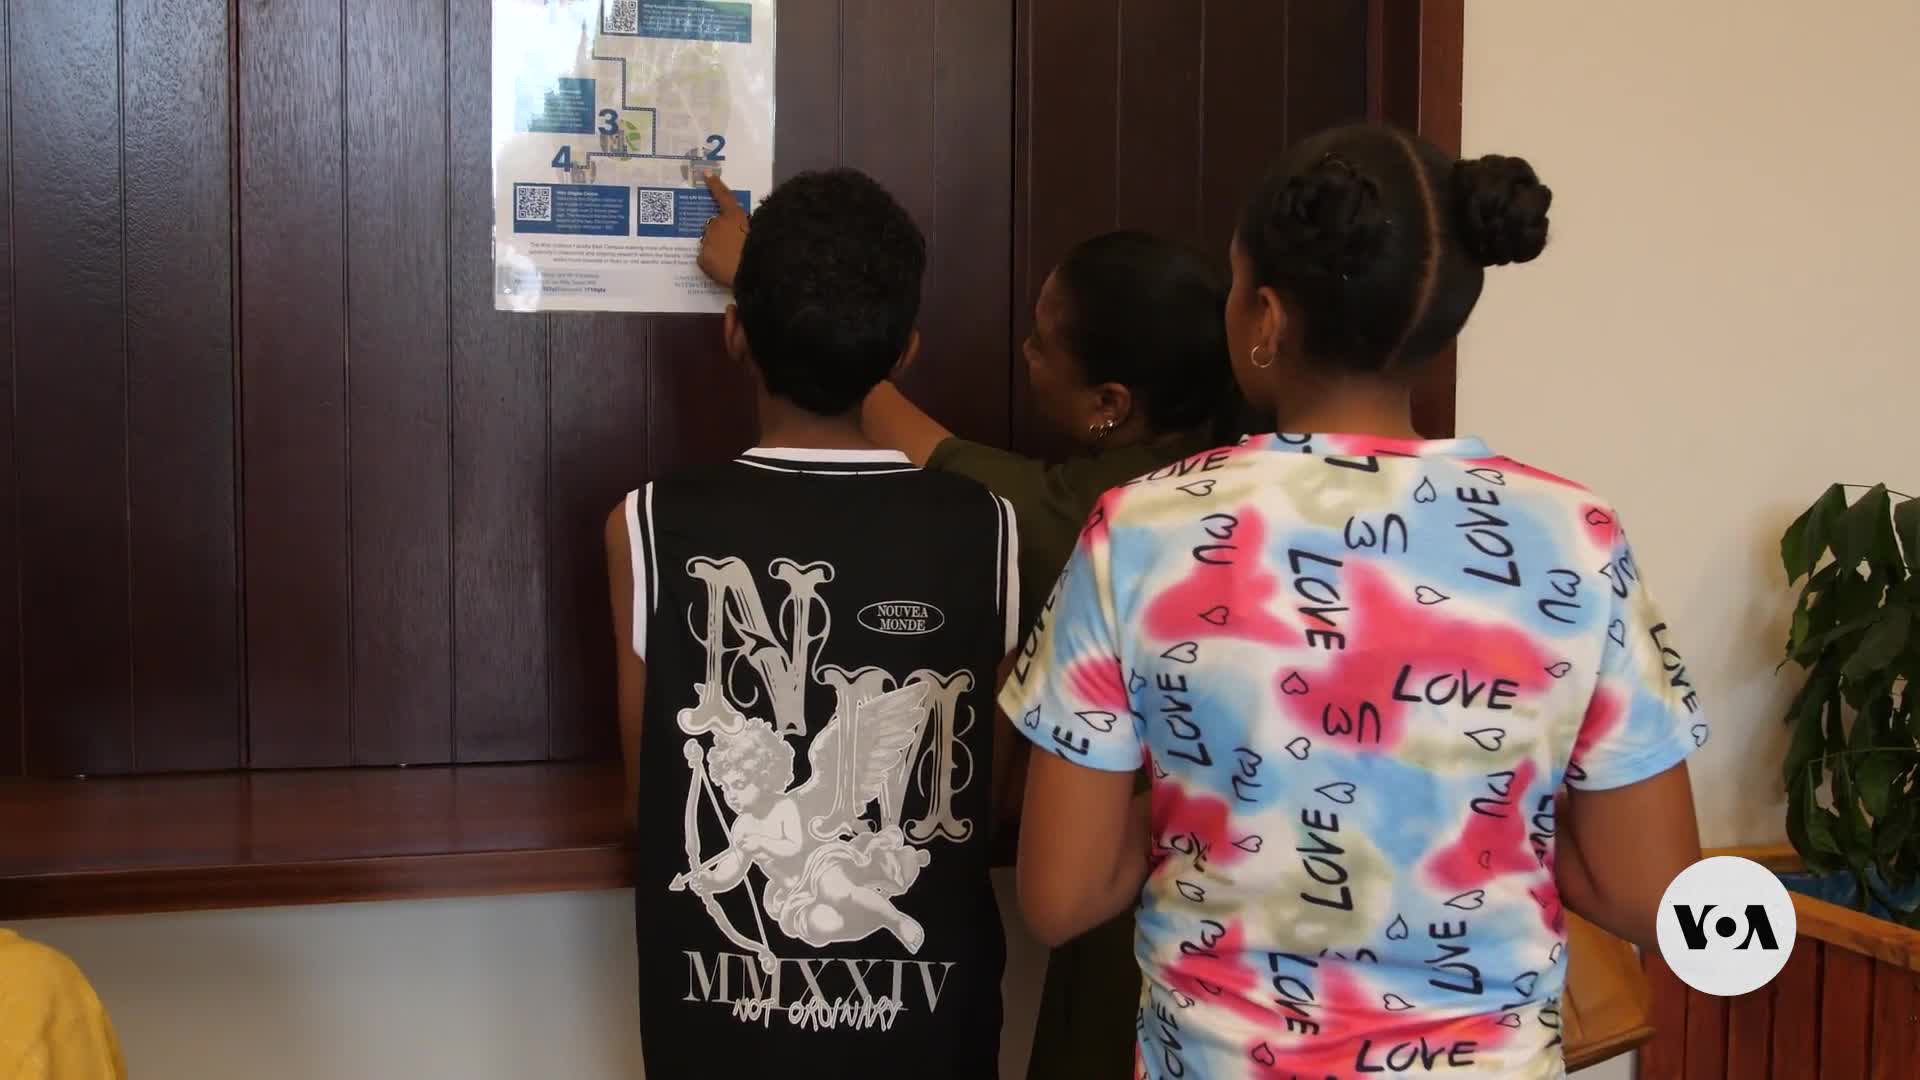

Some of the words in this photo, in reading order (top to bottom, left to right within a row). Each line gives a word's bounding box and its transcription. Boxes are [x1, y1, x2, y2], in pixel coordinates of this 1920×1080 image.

[598, 109, 619, 136] 3
[552, 145, 572, 172] 4
[706, 134, 726, 161] 2
[1455, 486, 1521, 587] LOVE
[877, 605, 929, 618] NOUVEA
[1287, 548, 1350, 650] LOVE
[880, 618, 926, 631] MONDE
[1392, 664, 1520, 710] LOVE
[1649, 622, 1698, 714] LOVE
[1156, 673, 1213, 767] LOVE
[1296, 808, 1353, 911] LOVE
[681, 950, 957, 1014] MMXXIV
[732, 997, 776, 1029] NOT
[788, 995, 903, 1032] ORDINARY
[1155, 1000, 1184, 1080] OVE
[1354, 1037, 1478, 1073] LOVE
